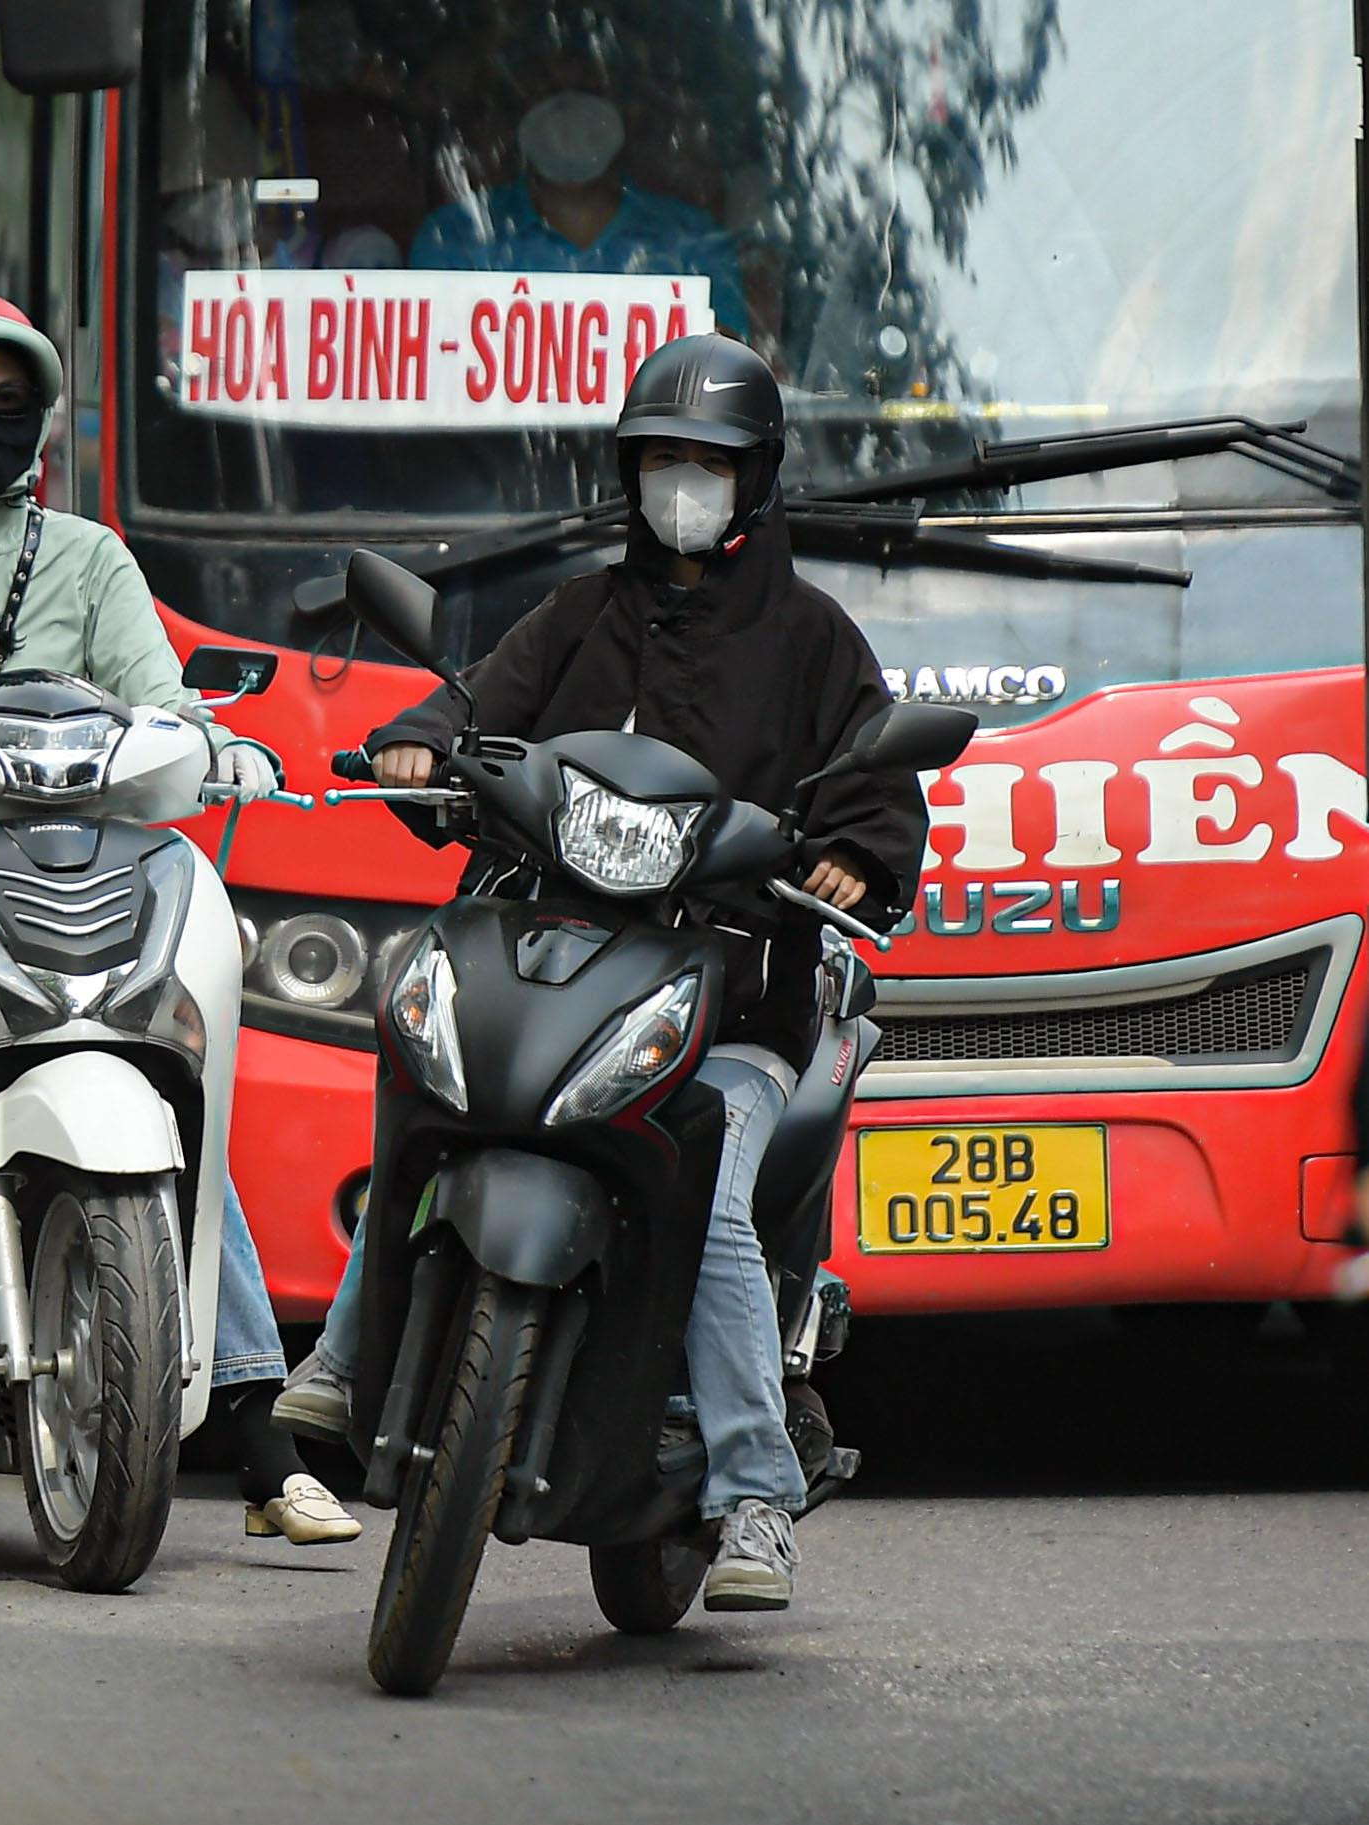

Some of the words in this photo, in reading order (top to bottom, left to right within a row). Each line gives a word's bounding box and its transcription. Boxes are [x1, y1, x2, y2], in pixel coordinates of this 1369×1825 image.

[190, 274, 290, 402] HÒA
[30, 824, 83, 834] HONDA
[891, 878, 1121, 936] UZU
[930, 1133, 1036, 1184] 28B
[888, 1189, 1080, 1243] 005.48
